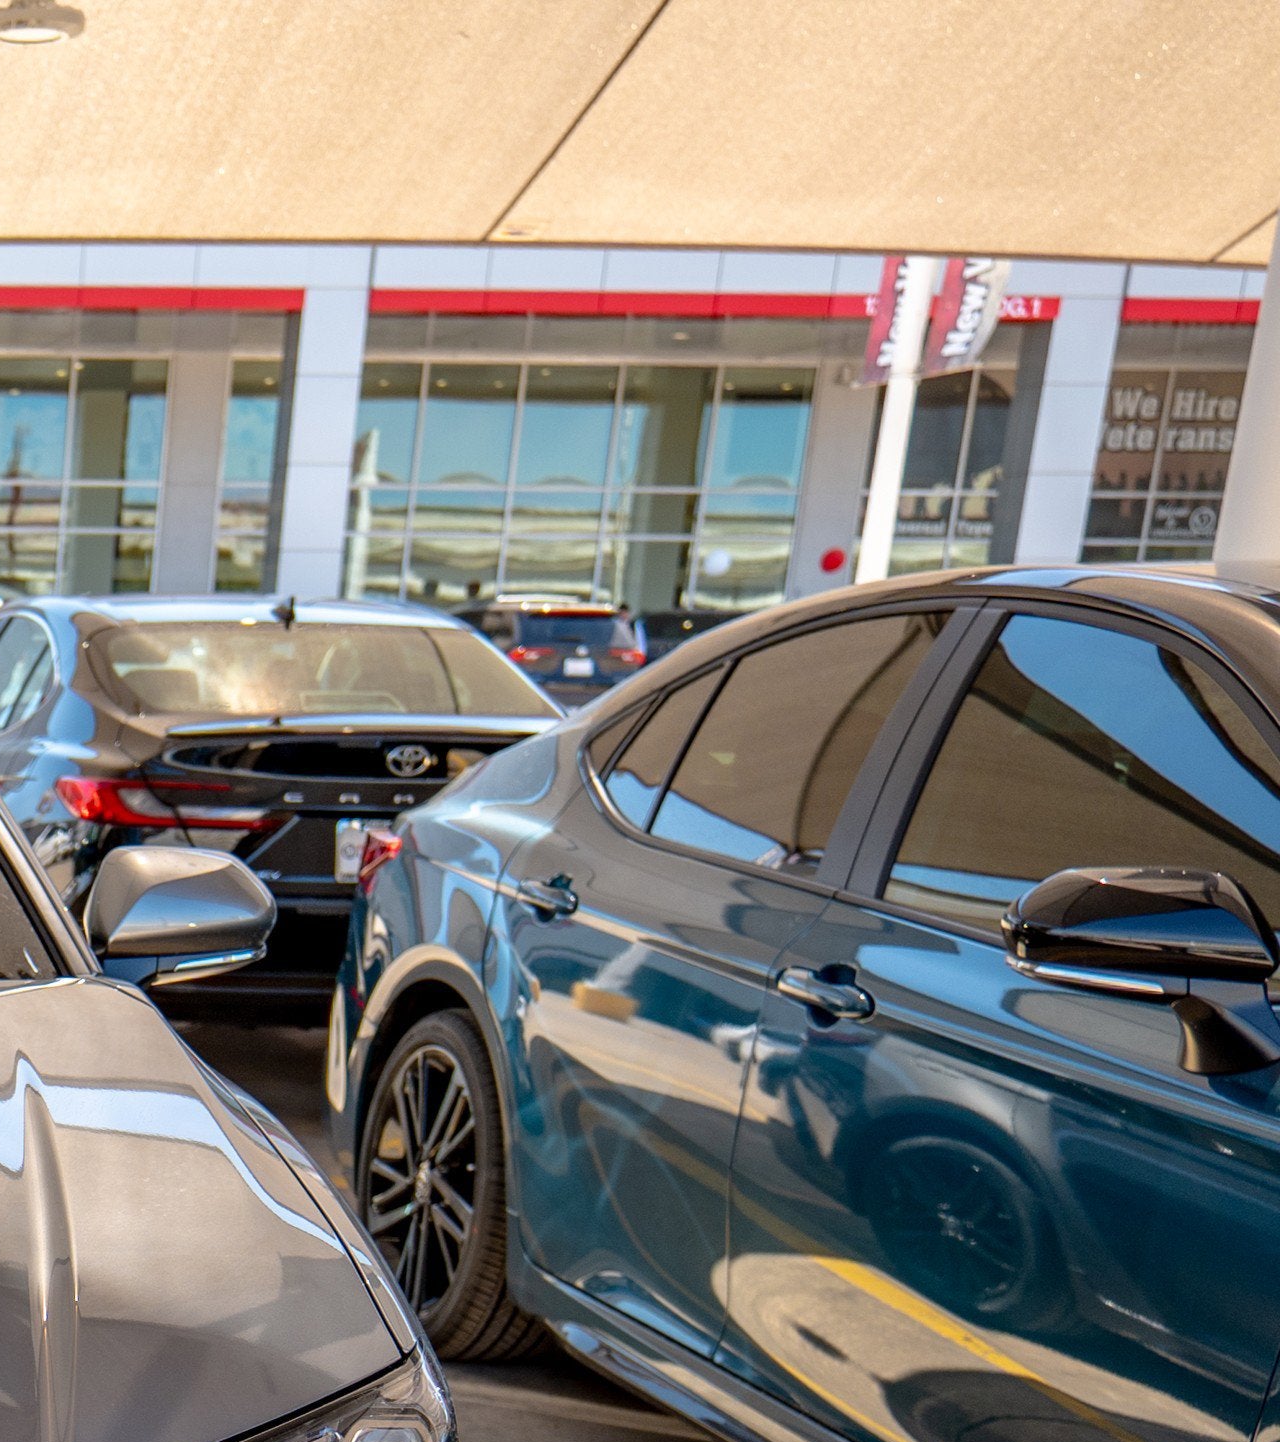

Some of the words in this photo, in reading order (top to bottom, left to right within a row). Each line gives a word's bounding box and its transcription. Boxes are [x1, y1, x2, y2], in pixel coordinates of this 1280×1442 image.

[941, 282, 989, 358] New
[1111, 388, 1161, 421] We
[1171, 390, 1239, 422] Hire
[1100, 423, 1235, 452] eterans
